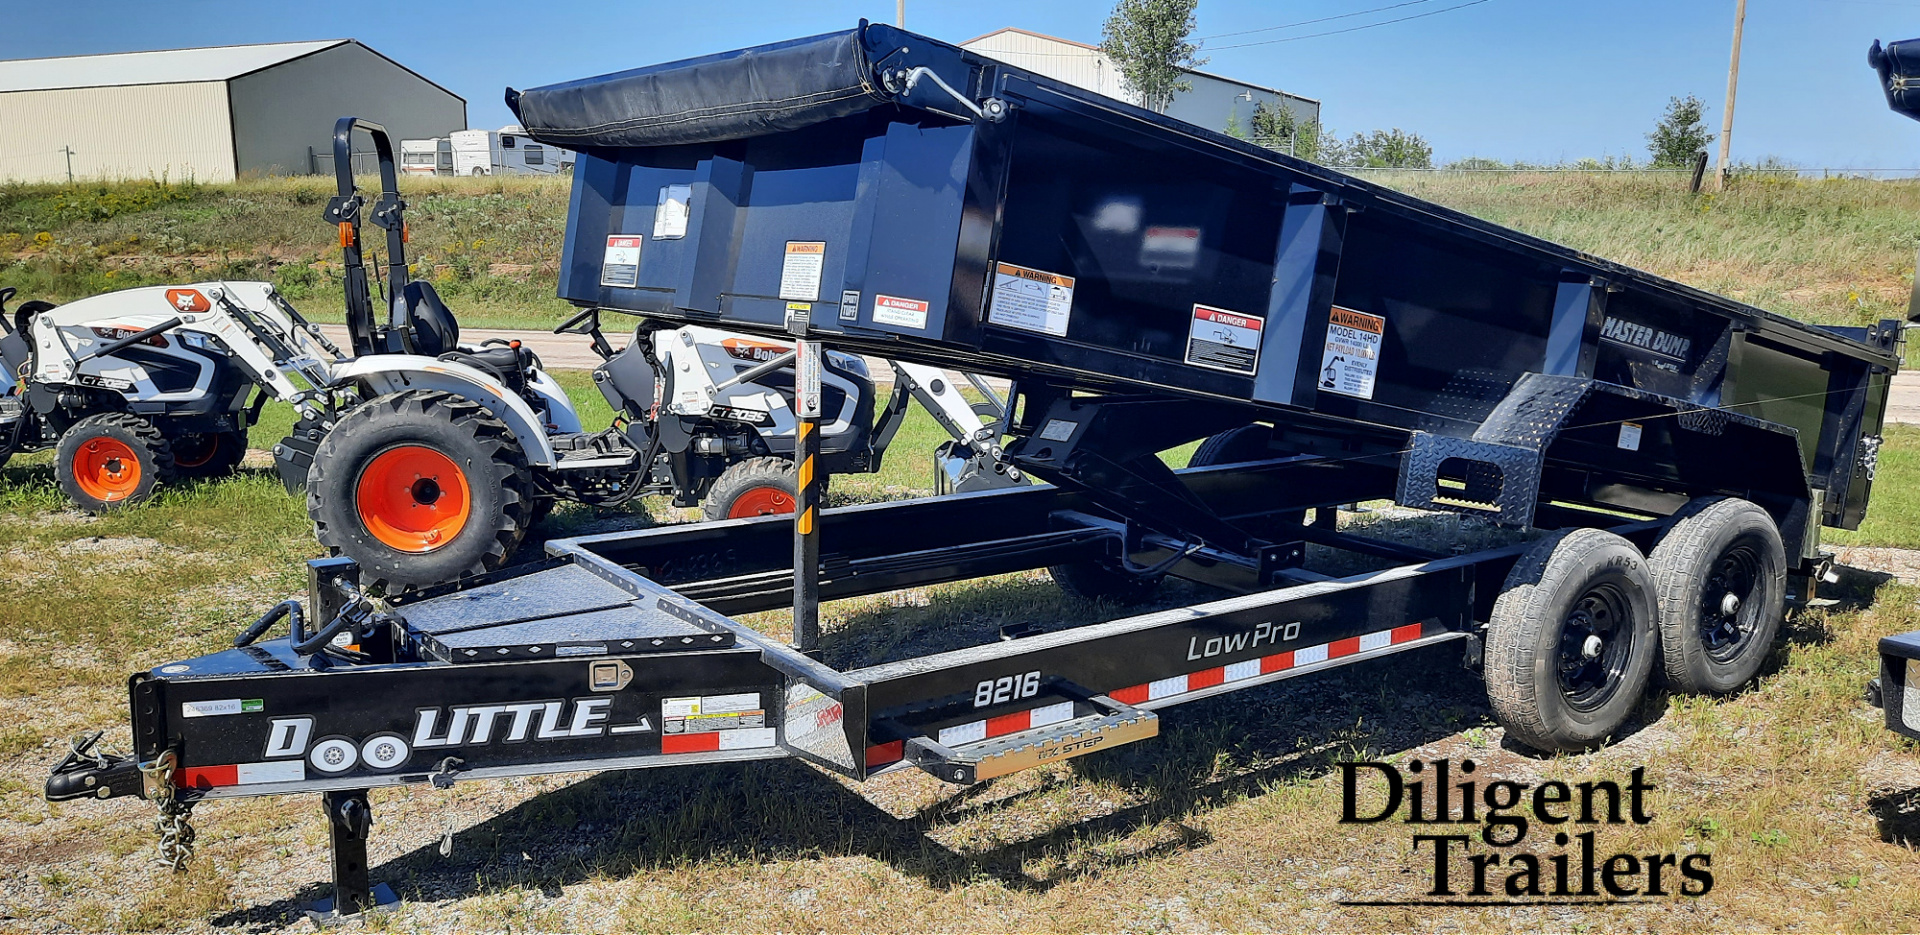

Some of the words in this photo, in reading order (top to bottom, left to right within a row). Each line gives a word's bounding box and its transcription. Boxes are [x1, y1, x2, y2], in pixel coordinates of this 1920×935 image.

[1023, 270, 1057, 284] WARNING
[891, 300, 919, 310] DANGER
[1217, 314, 1247, 328] DANGER
[1340, 313, 1379, 332] WARNING
[1329, 326, 1357, 340] MODEL
[1360, 333, 1379, 344] 14HD
[1600, 316, 1653, 348] MASTER
[1652, 331, 1690, 357] DUMP
[1335, 344, 1355, 356] PAYLOAD
[708, 406, 768, 423] CT2035
[1606, 555, 1638, 571] KR53
[974, 671, 1041, 708] 8216
[1062, 736, 1104, 754] STEP
